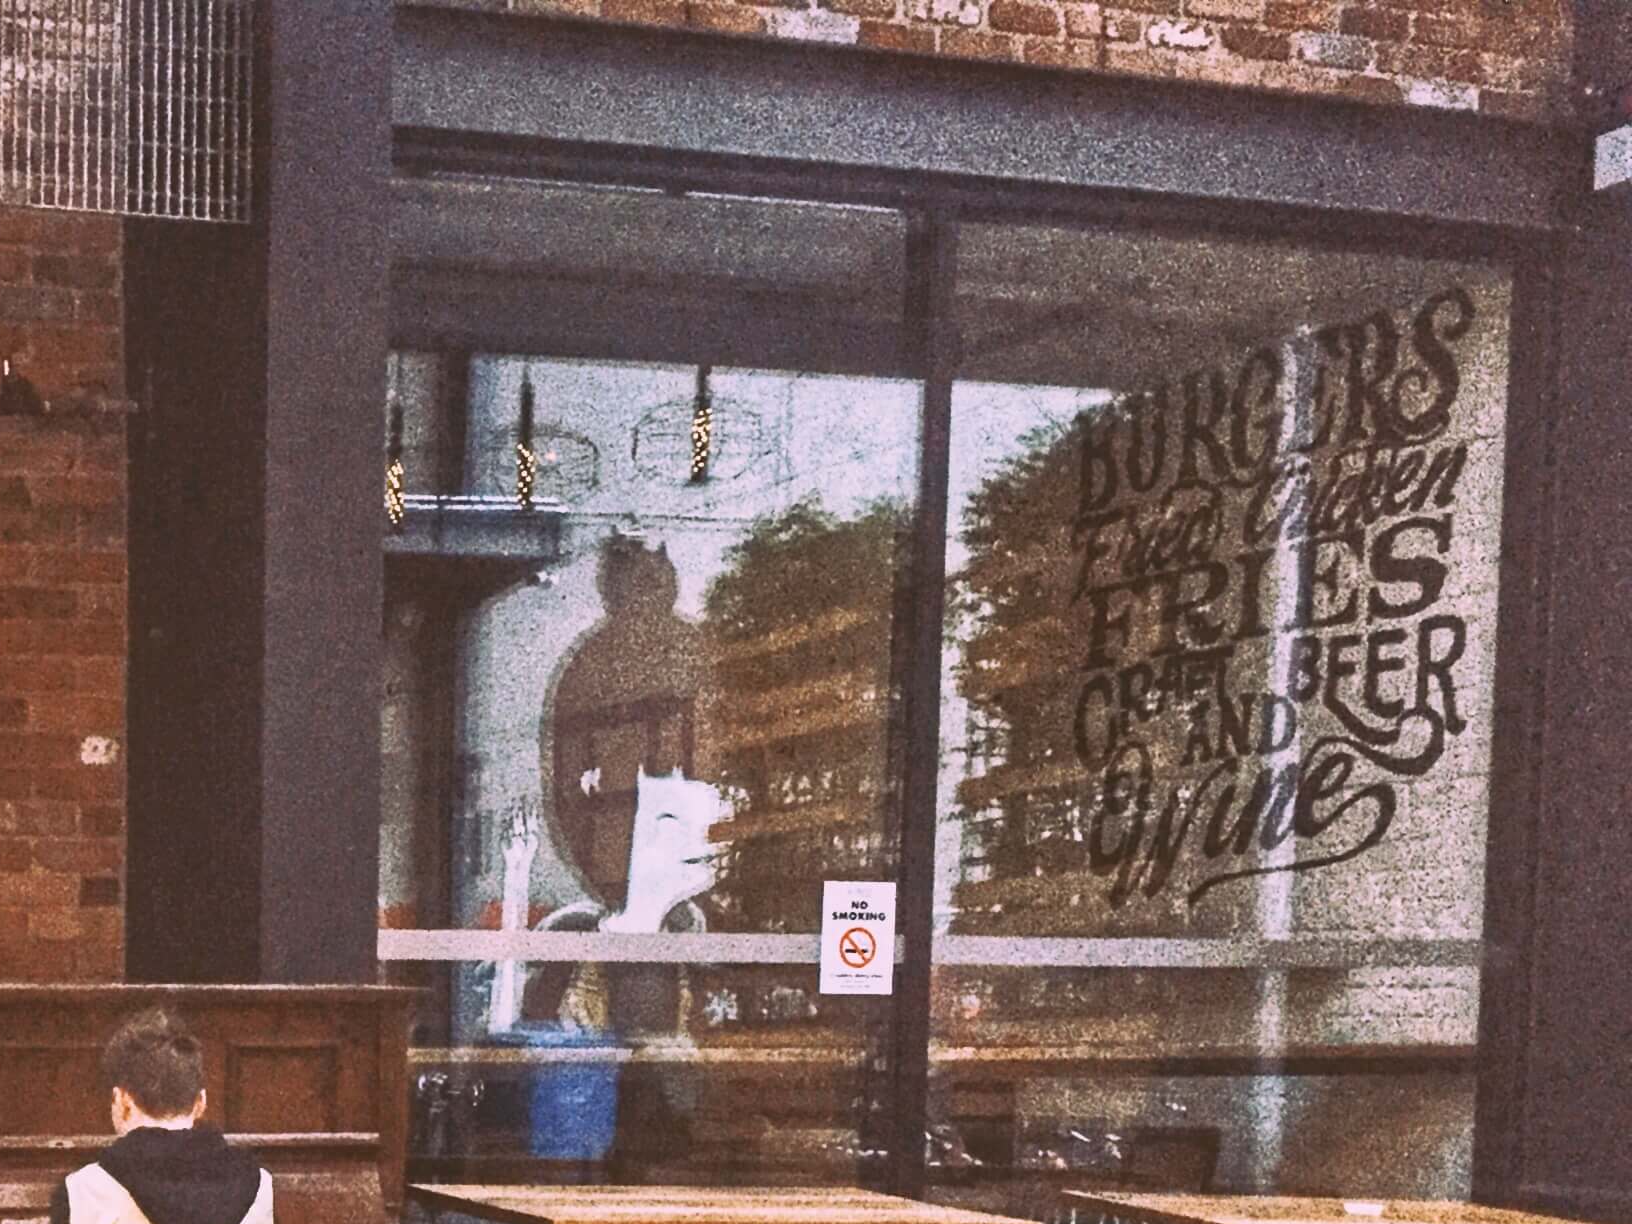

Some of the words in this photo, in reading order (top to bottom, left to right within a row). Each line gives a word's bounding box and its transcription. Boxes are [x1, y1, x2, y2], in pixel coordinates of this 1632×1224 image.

[1070, 287, 1474, 518] BURGERS
[1076, 513, 1452, 672] FRIES
[1179, 690, 1297, 766] AND
[1288, 615, 1466, 778] BEER
[832, 911, 886, 921] SMOKING
[851, 901, 868, 910] NO
